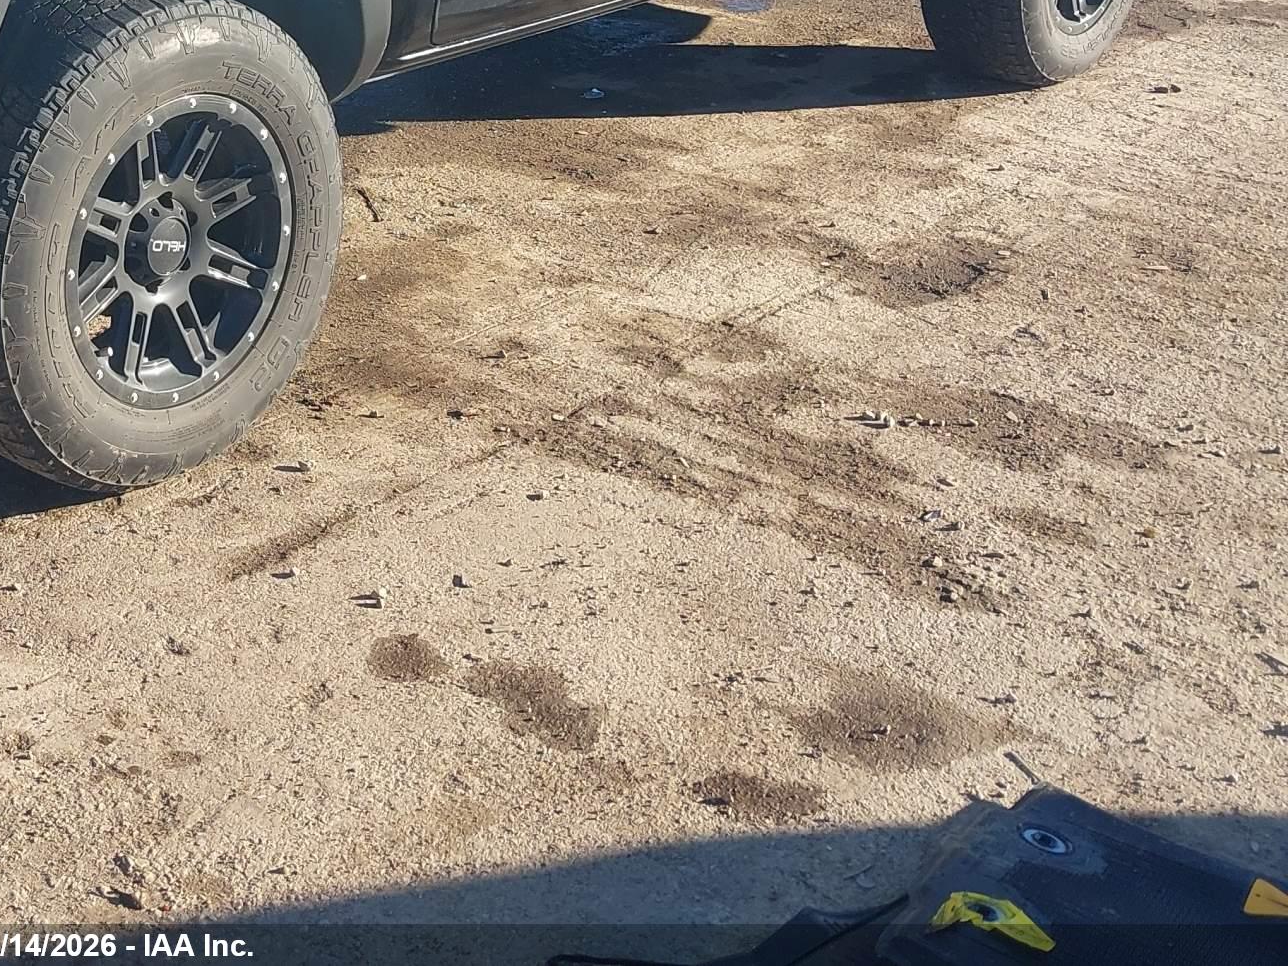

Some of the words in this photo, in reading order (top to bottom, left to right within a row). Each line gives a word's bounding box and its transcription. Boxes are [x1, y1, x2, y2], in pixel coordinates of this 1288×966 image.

[153, 240, 186, 252] HELO
[221, 60, 297, 126] TERRA
[287, 130, 322, 323] GRAPPLER
